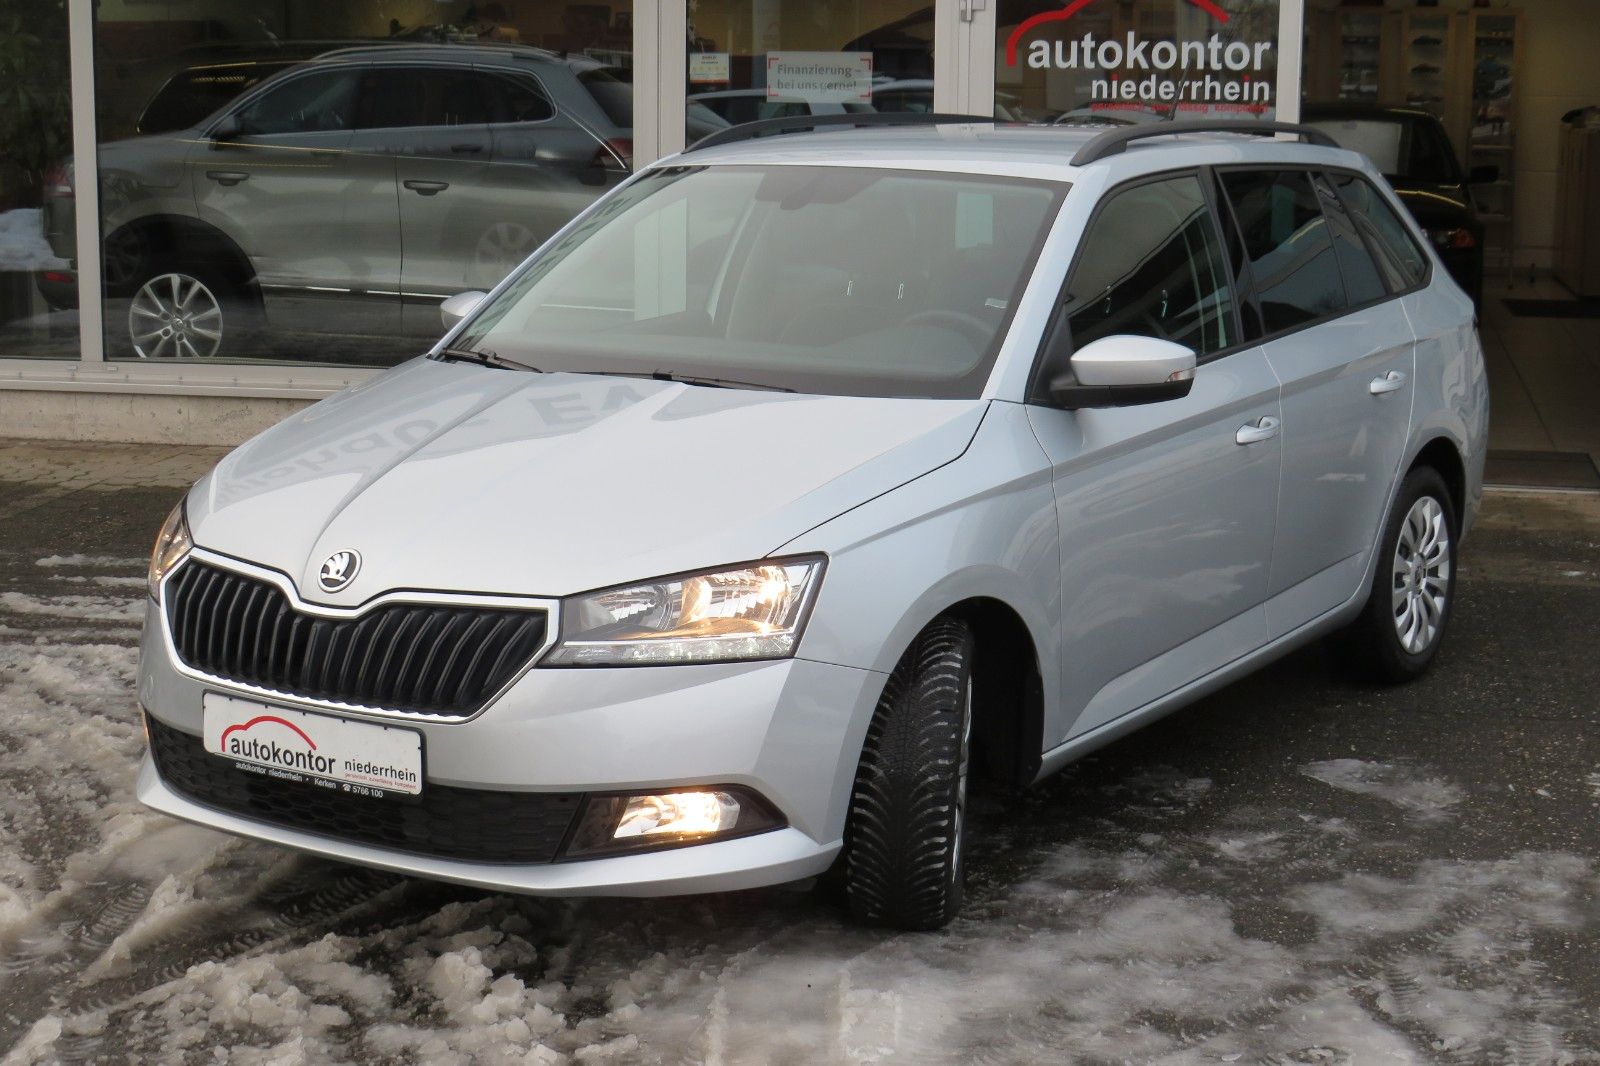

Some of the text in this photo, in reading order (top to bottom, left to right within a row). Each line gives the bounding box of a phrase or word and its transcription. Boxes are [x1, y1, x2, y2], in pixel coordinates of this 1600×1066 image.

[1028, 31, 1271, 70] autokontor
[777, 64, 852, 77] Finanzierung
[777, 79, 794, 90] bei
[796, 81, 817, 90] uns
[1091, 74, 1270, 101] niederrhein
[231, 738, 336, 774] autokontor
[235, 761, 267, 775] autokontor
[269, 768, 303, 782] niederrhein
[314, 777, 336, 789] Kerken
[370, 788, 384, 798] 100
[344, 759, 416, 782] niederrhein
